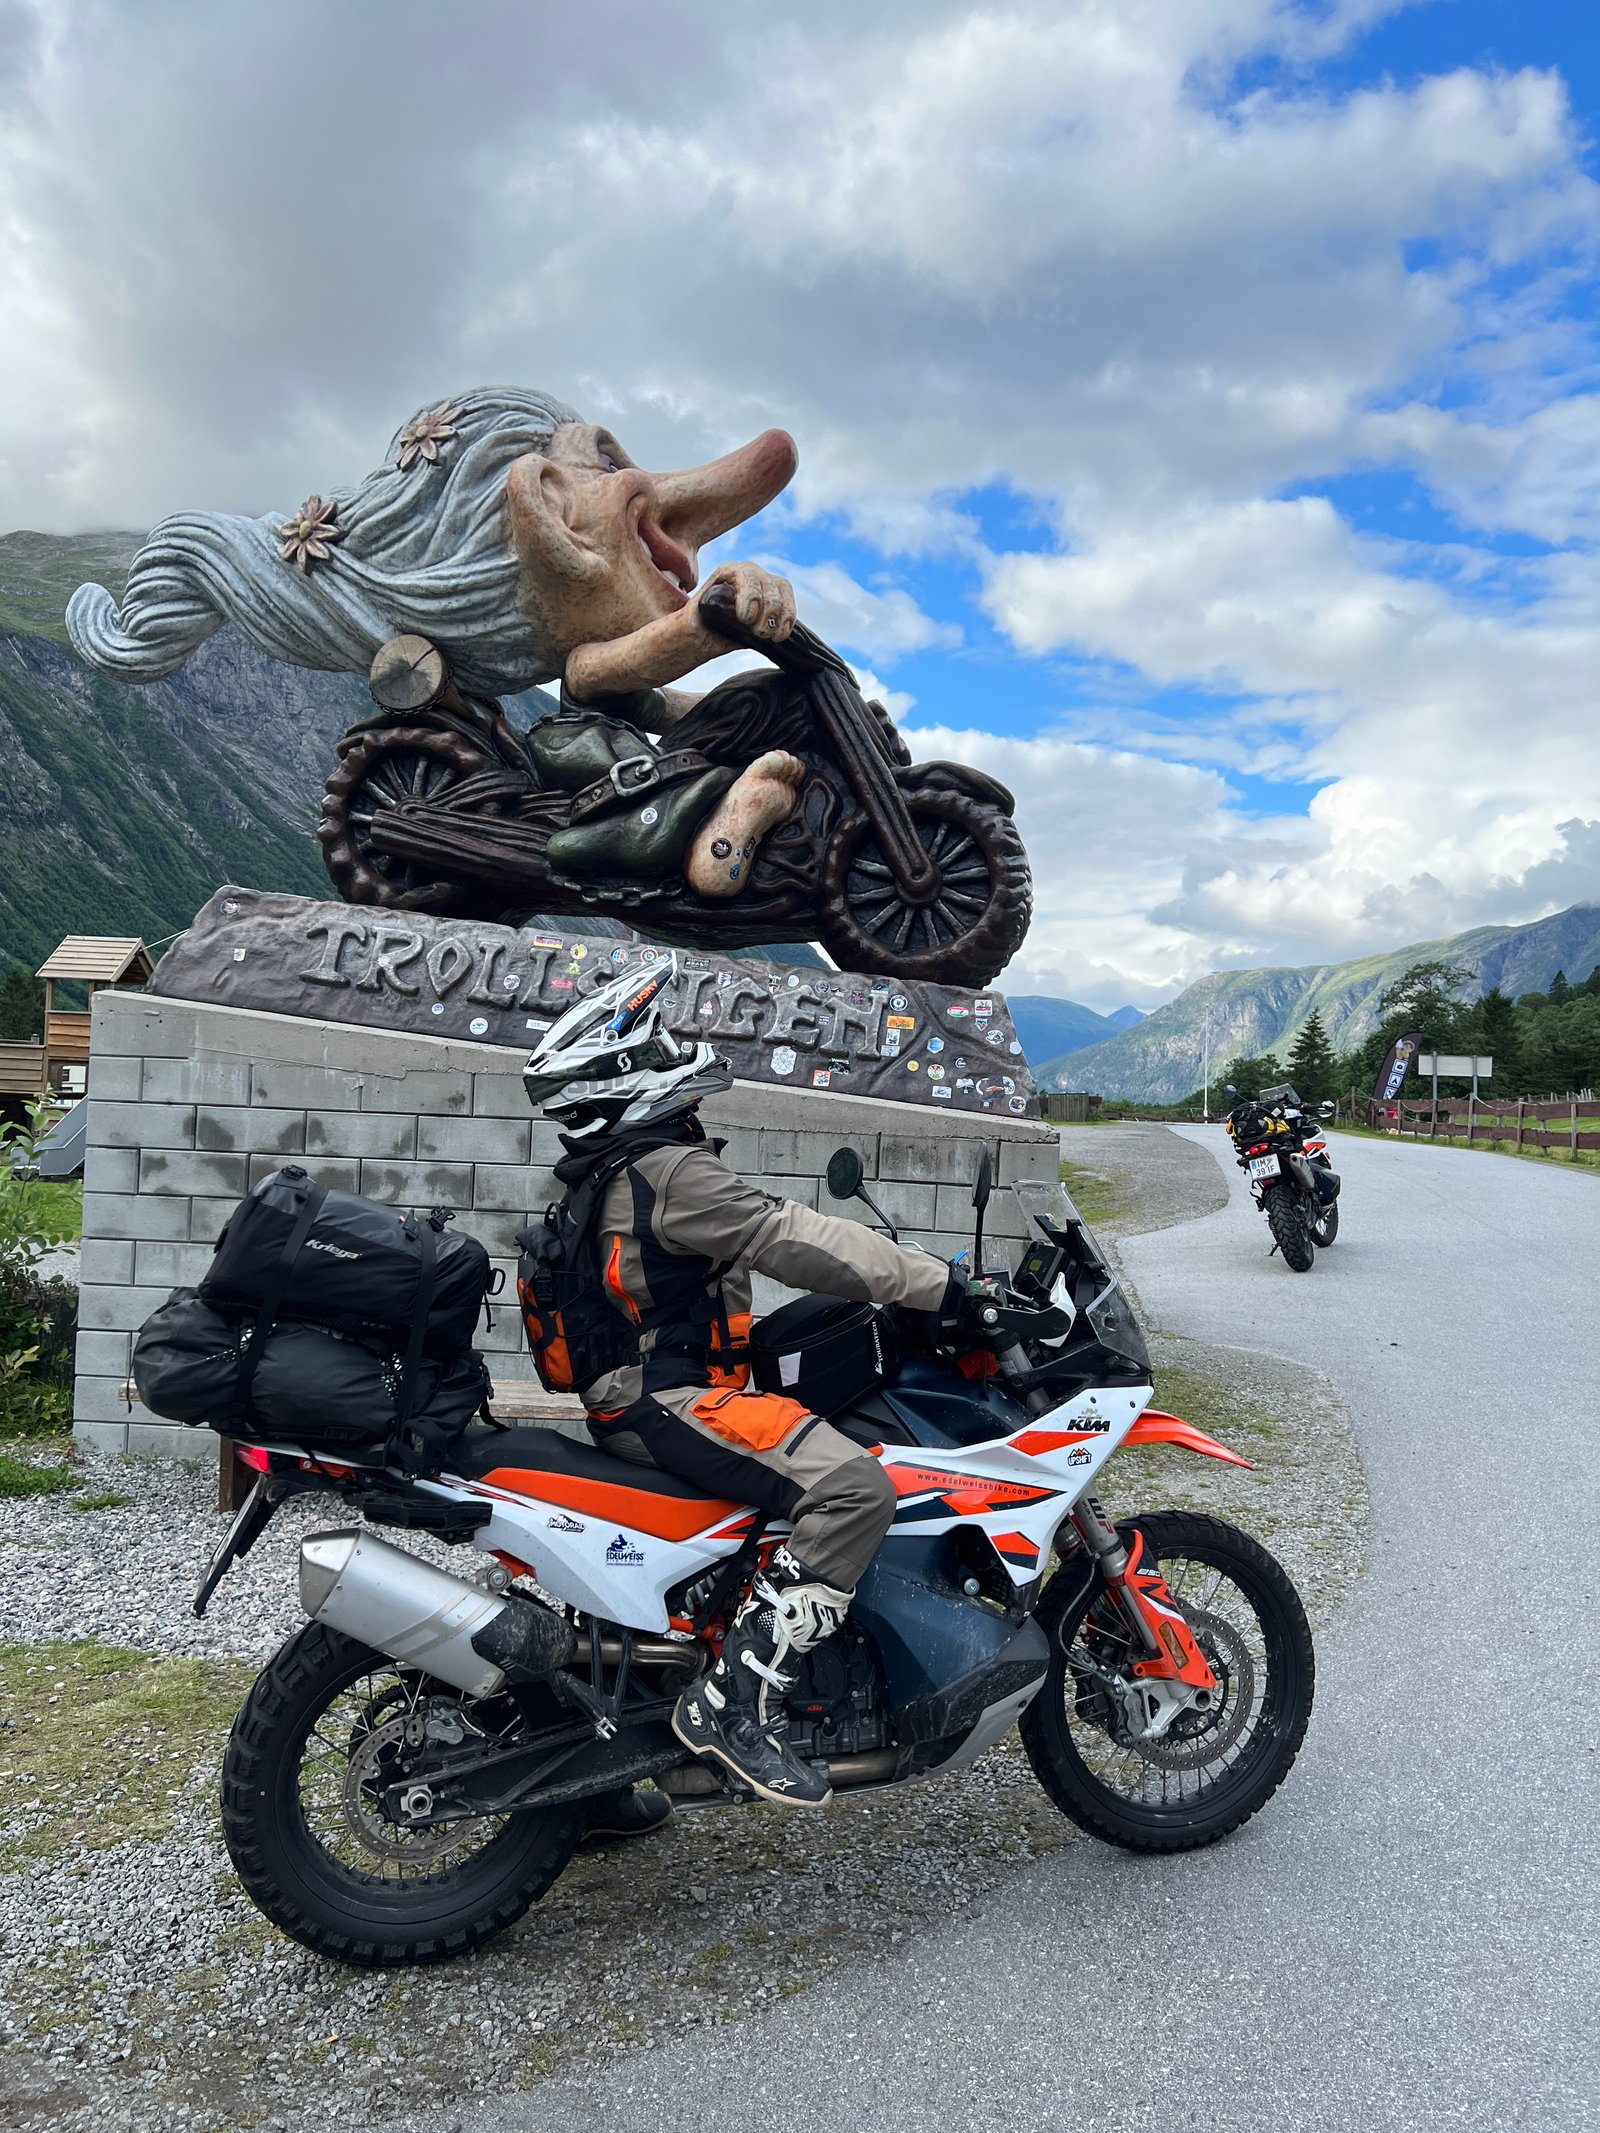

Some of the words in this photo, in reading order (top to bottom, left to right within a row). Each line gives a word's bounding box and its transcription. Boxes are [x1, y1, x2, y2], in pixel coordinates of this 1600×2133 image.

[300, 921, 889, 1060] TROLLIGEN
[627, 979, 659, 1011] HUSKY
[305, 1239, 359, 1259] Kriega
[872, 1321, 883, 1361] TOURATECH
[1067, 1419, 1110, 1432] KTM
[917, 1473, 1030, 1496] www.edelweissbike.com
[606, 1552, 644, 1561] EDELWEISS
